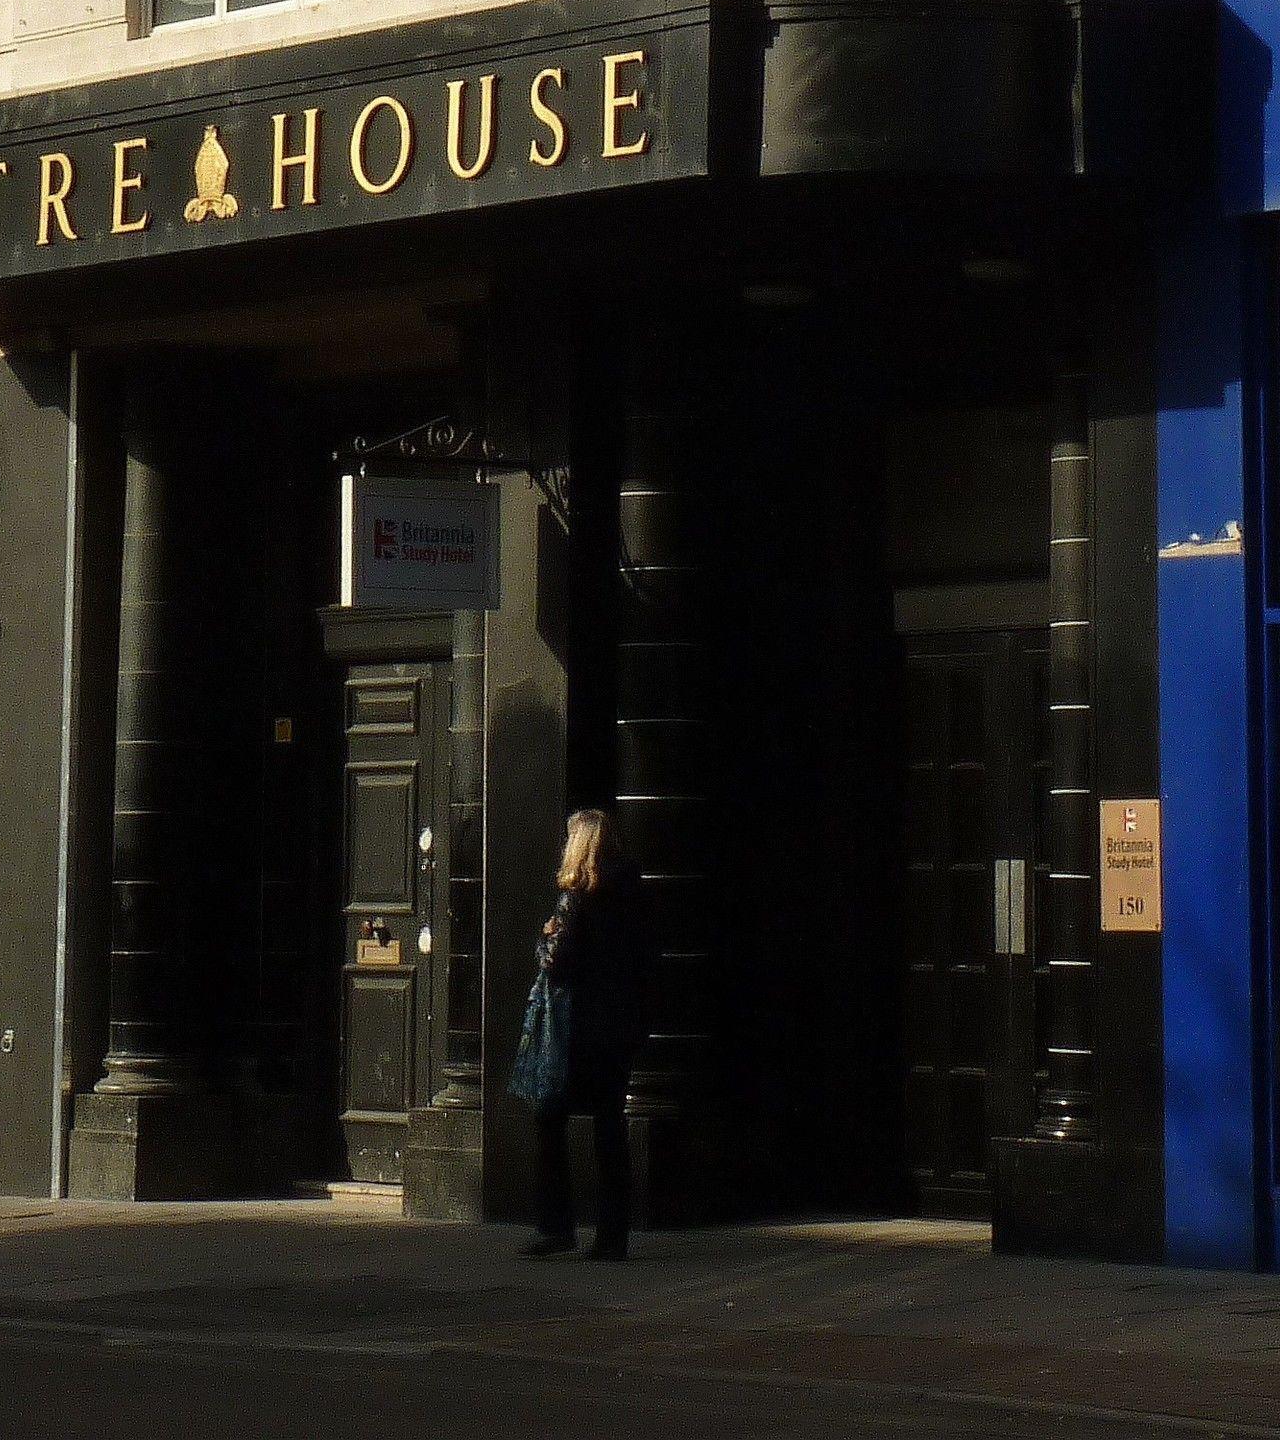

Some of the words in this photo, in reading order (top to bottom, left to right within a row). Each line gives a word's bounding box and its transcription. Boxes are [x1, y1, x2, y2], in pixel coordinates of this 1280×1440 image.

[269, 49, 650, 212] HOUSE
[401, 520, 476, 545] Britannia
[401, 544, 439, 566] Study
[440, 545, 476, 564] Hotel
[1106, 836, 1154, 854] Britannia
[1106, 855, 1130, 872] Study
[1131, 856, 1154, 869] Hotel
[1118, 896, 1145, 916] 150
